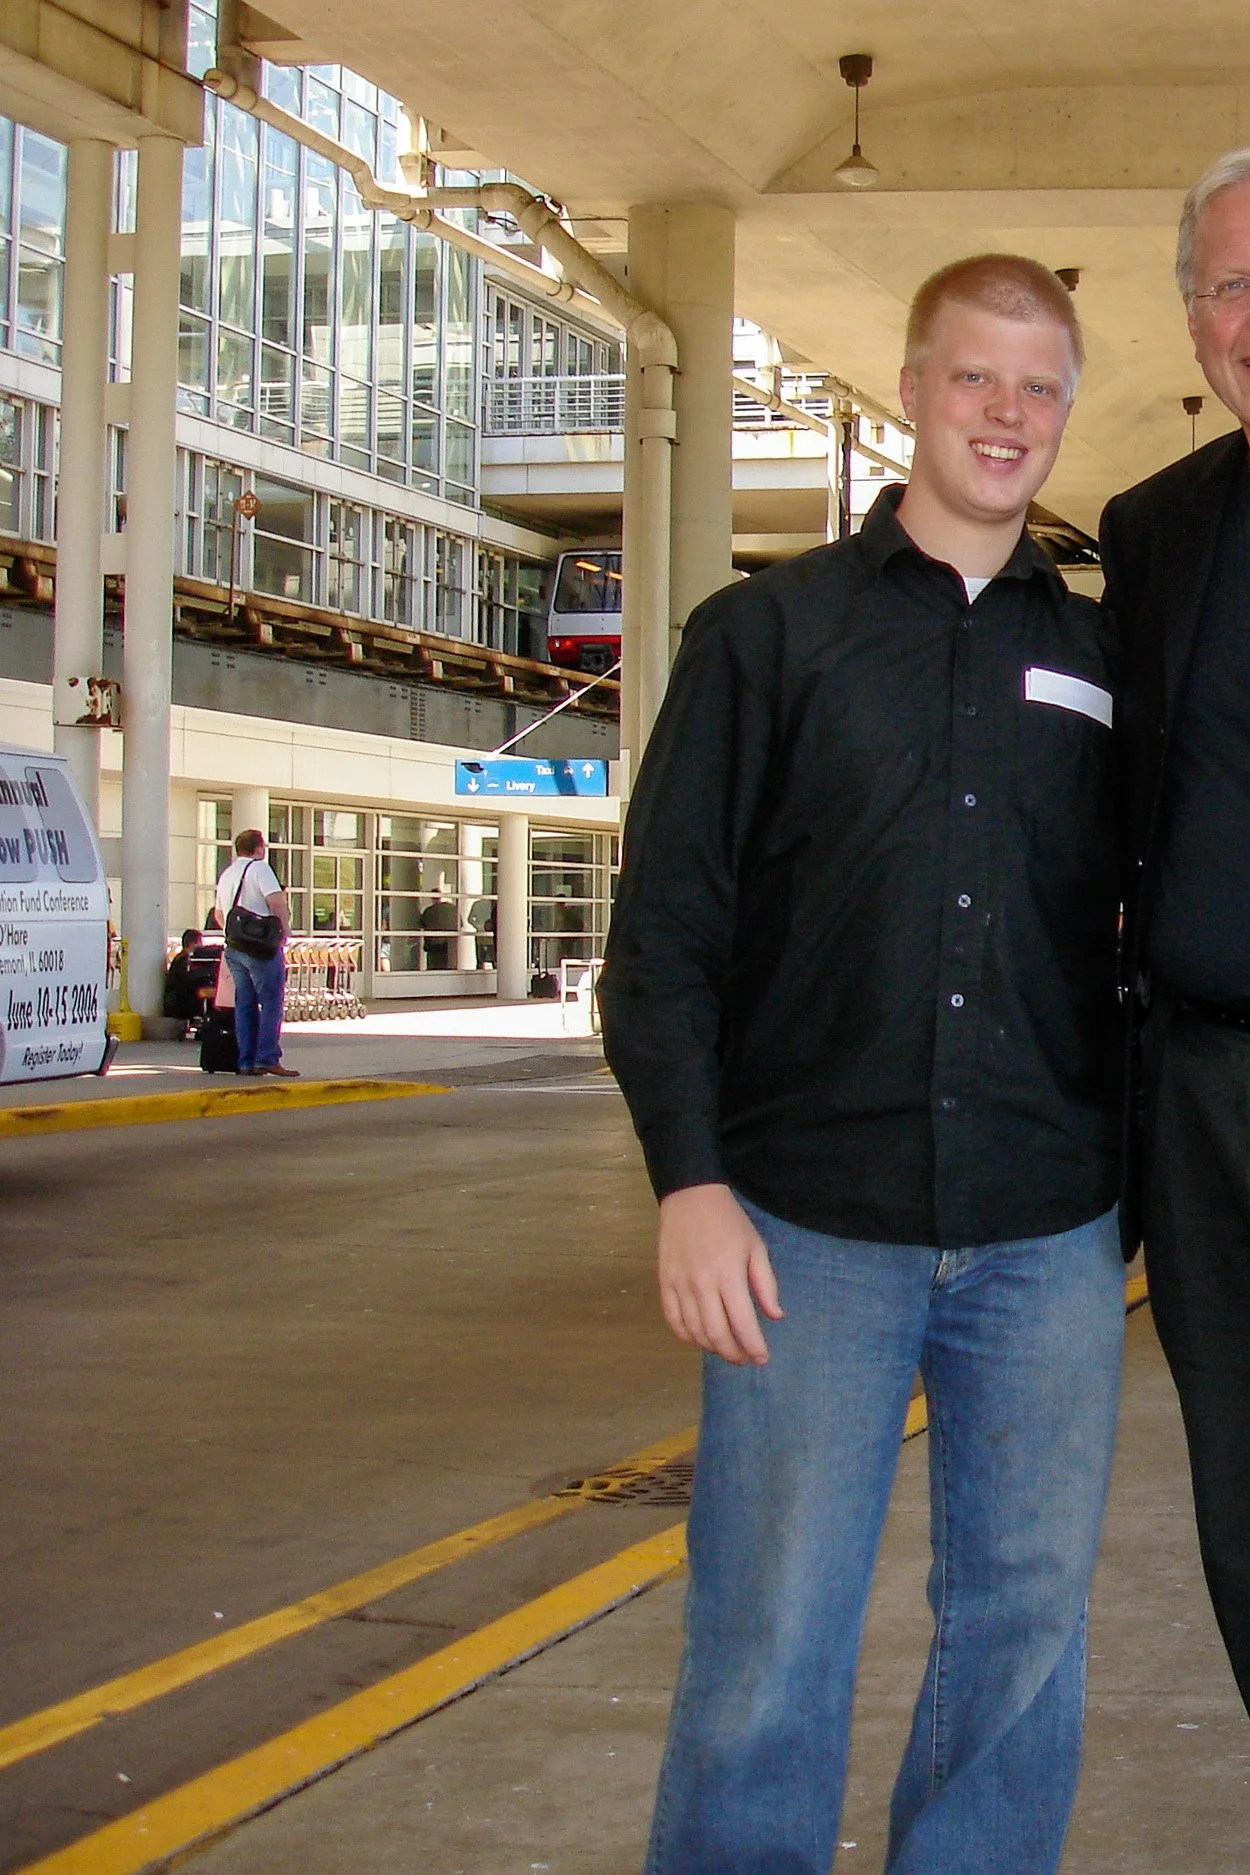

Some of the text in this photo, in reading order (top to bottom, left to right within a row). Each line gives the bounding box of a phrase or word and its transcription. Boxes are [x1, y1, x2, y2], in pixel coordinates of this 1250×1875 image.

[506, 780, 536, 793] Livery
[23, 828, 70, 866] PUSH
[20, 889, 41, 912] Fund
[43, 888, 89, 912] Conference
[29, 951, 37, 973] IL
[39, 949, 64, 972] 60018
[7, 983, 98, 1031] June 10-15 2006
[22, 1040, 84, 1071] Register Today!
